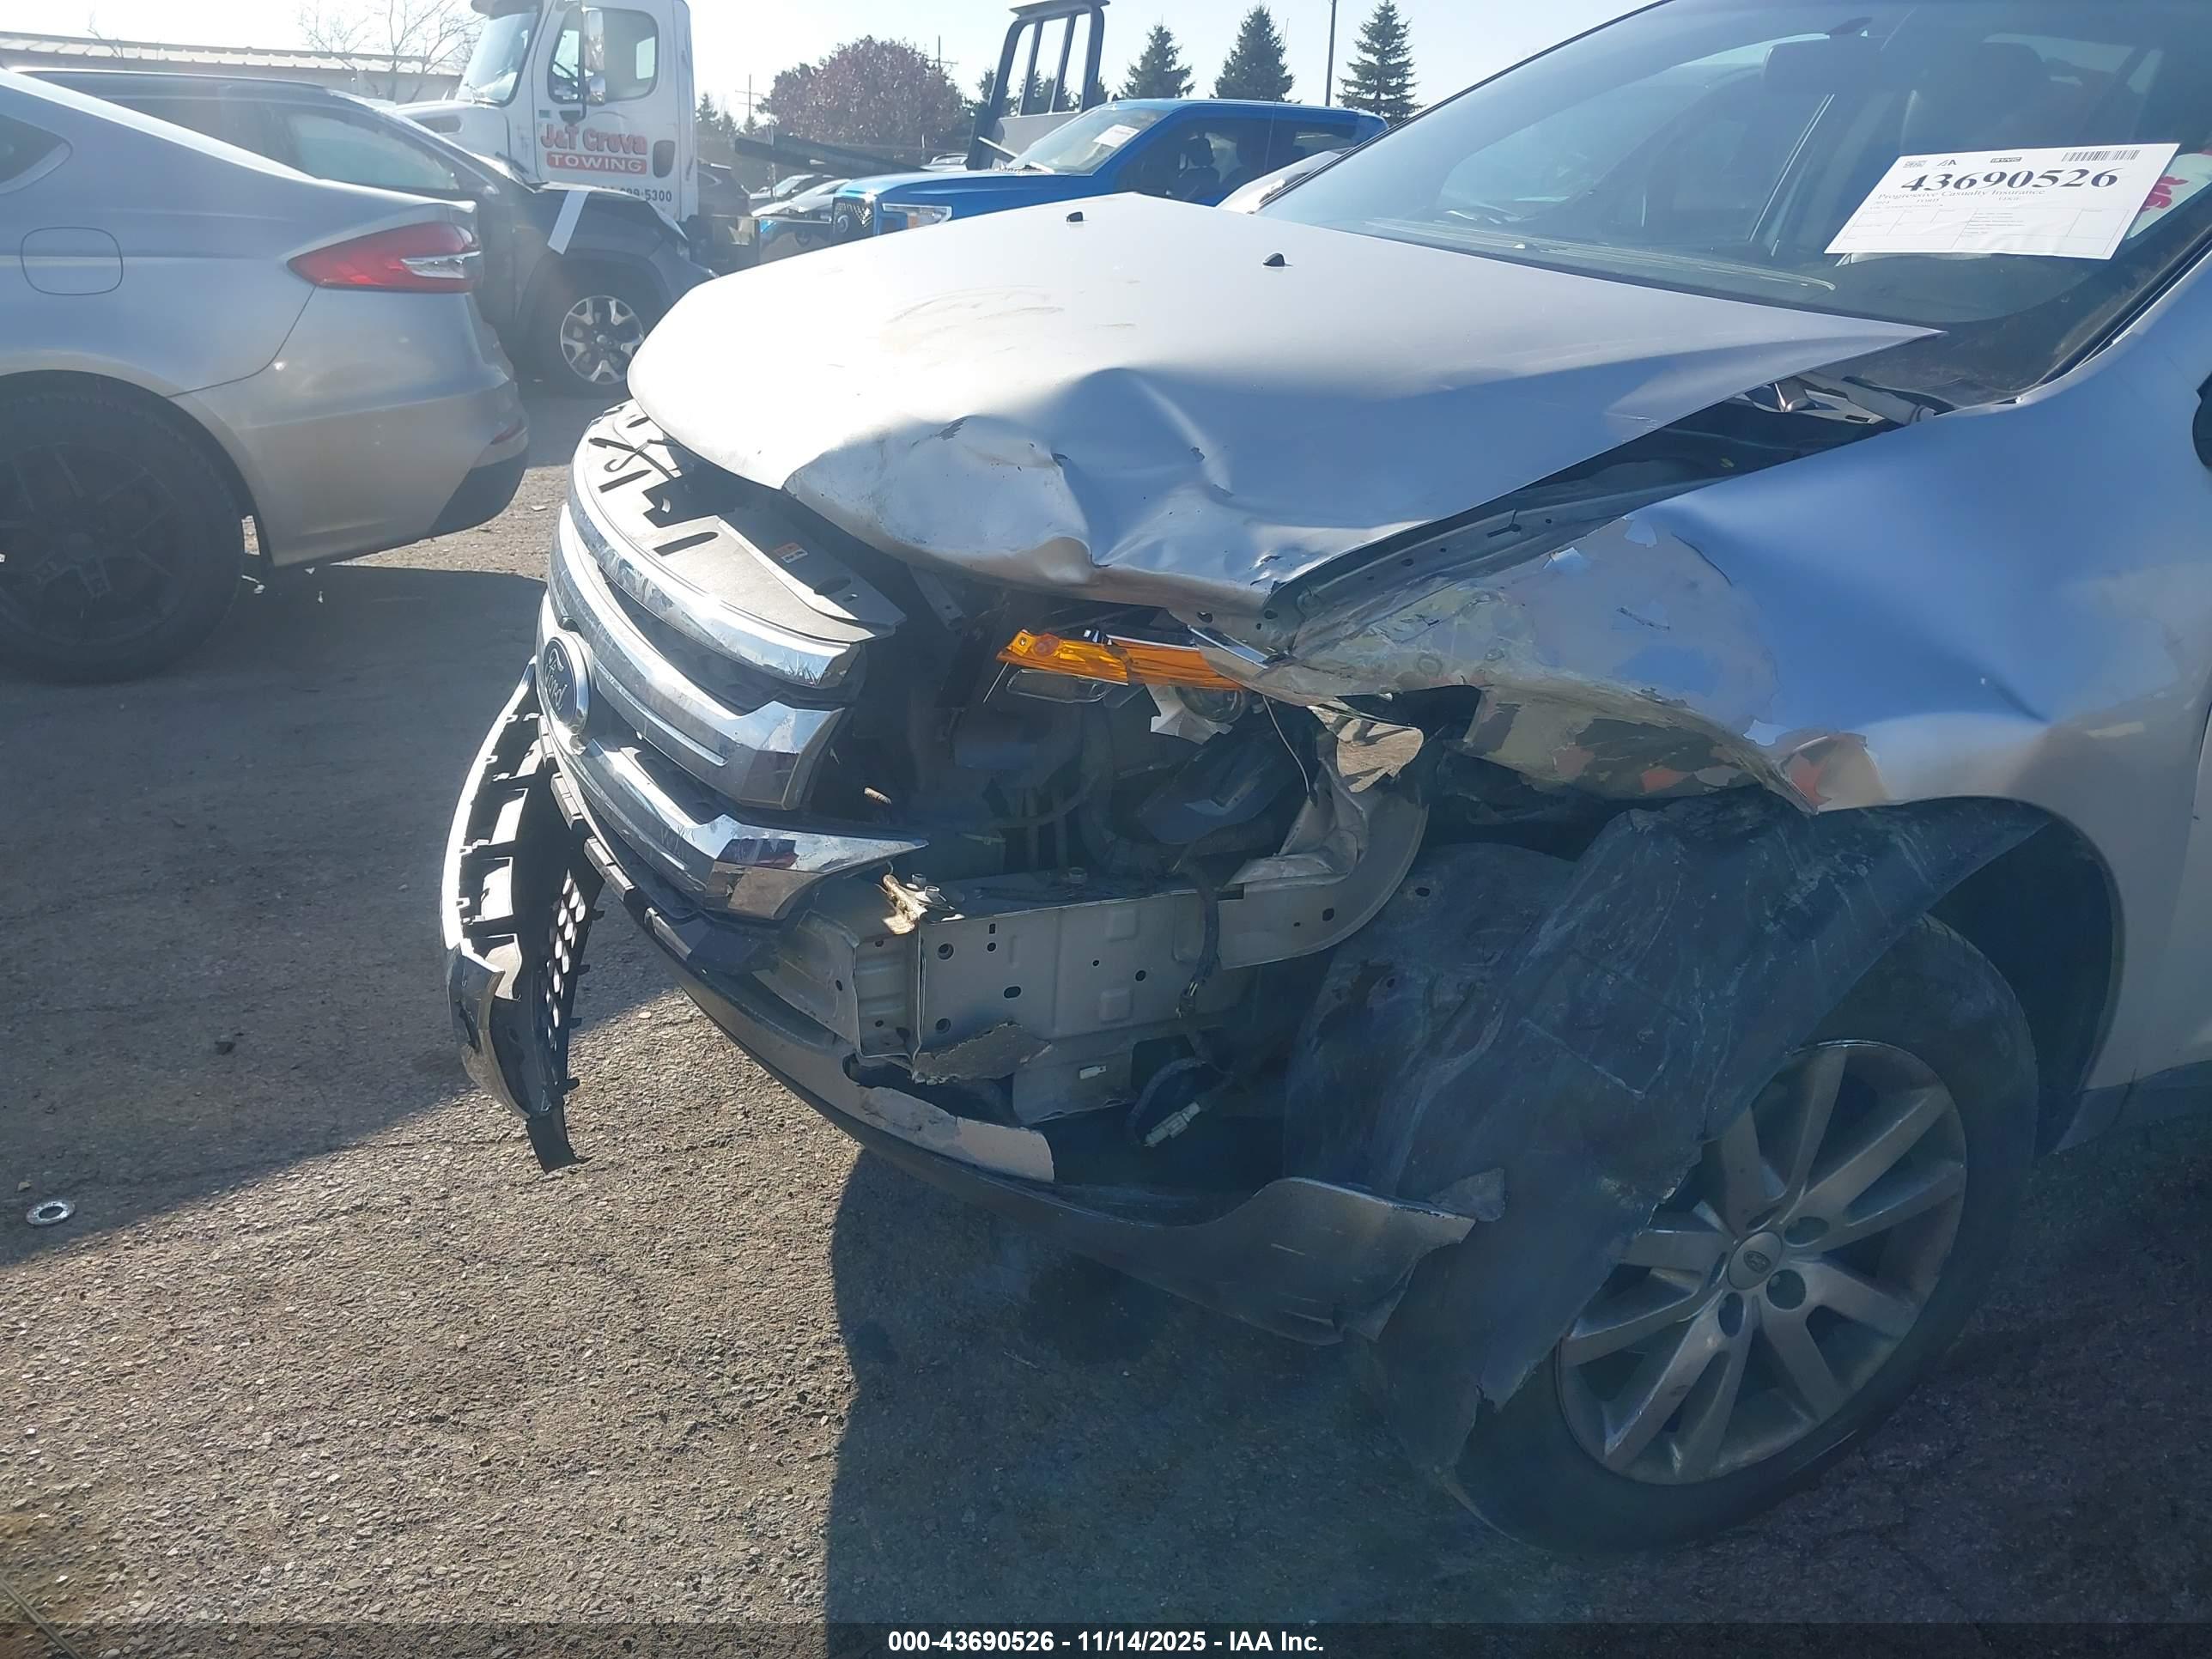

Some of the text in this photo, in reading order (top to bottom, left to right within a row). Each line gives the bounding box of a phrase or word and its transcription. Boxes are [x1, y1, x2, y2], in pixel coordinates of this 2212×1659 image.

[540, 124, 580, 150] J&T
[550, 154, 643, 173] TOWING
[1900, 167, 2124, 191] 43690526
[1877, 191, 1939, 200] Progressive
